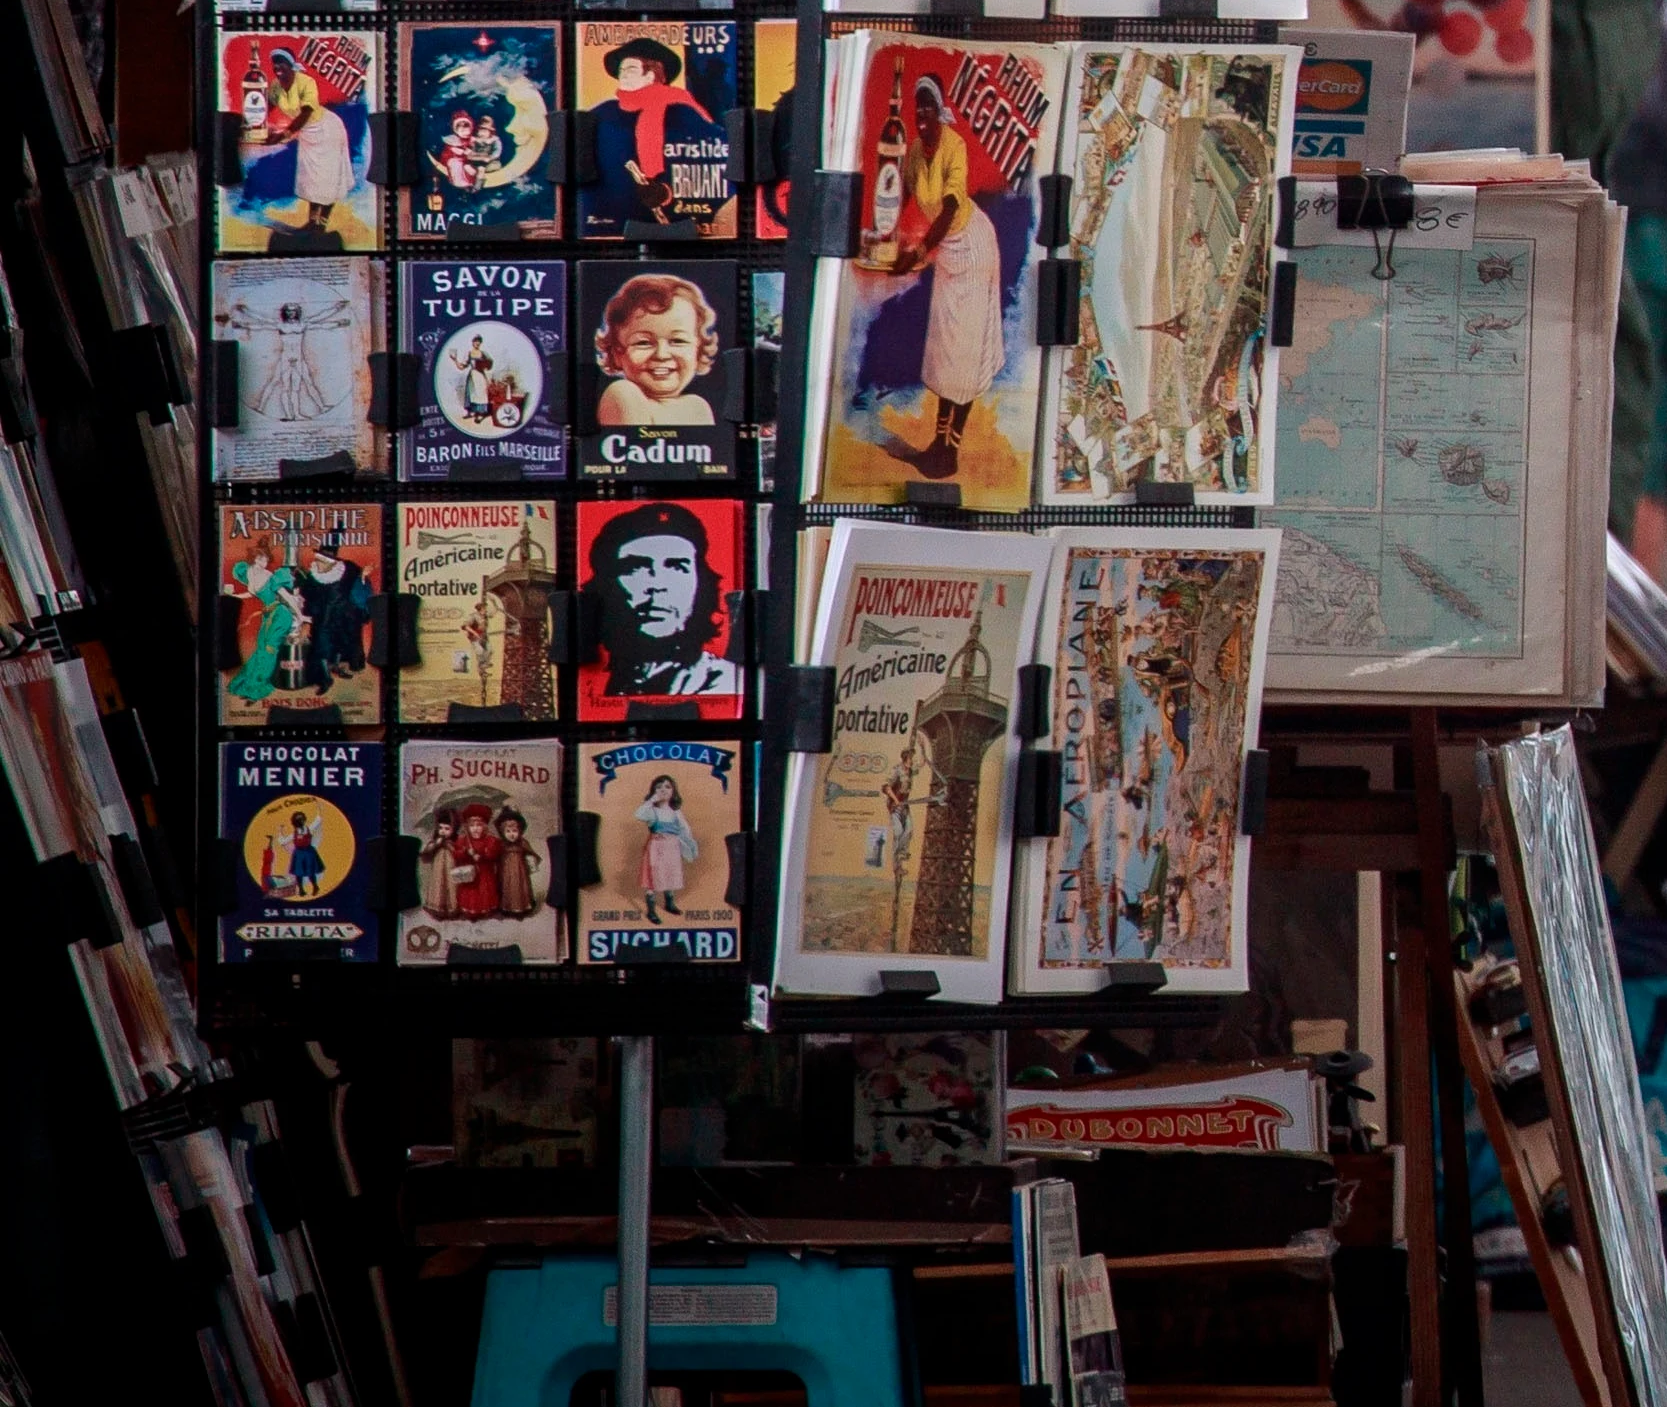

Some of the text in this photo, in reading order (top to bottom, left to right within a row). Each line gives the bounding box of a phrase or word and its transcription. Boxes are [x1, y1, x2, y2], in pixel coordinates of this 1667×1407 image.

[336, 35, 372, 70] RHUM
[995, 52, 1050, 129] RHUM
[664, 137, 729, 158] aristide
[674, 201, 712, 214] dans
[433, 266, 546, 292] SAVON
[423, 298, 554, 317] TULIPE
[639, 426, 677, 438] Savon
[417, 442, 561, 462] BARON FILS MARSEILLE
[602, 434, 711, 463] Cadum
[585, 465, 611, 474] POUR
[616, 465, 627, 473] LA
[404, 545, 504, 581] Américaine
[408, 580, 478, 595] portative
[835, 647, 947, 704] Américaine
[835, 705, 909, 742] portative
[244, 747, 360, 762] CHOCOLAT
[601, 745, 727, 770] CHOCOLAT
[238, 767, 364, 787] MENIER
[411, 758, 550, 785] PH. SUCHARD
[264, 908, 335, 917] SA TABLETTE
[1029, 1110, 1255, 1140] DUBONNET
